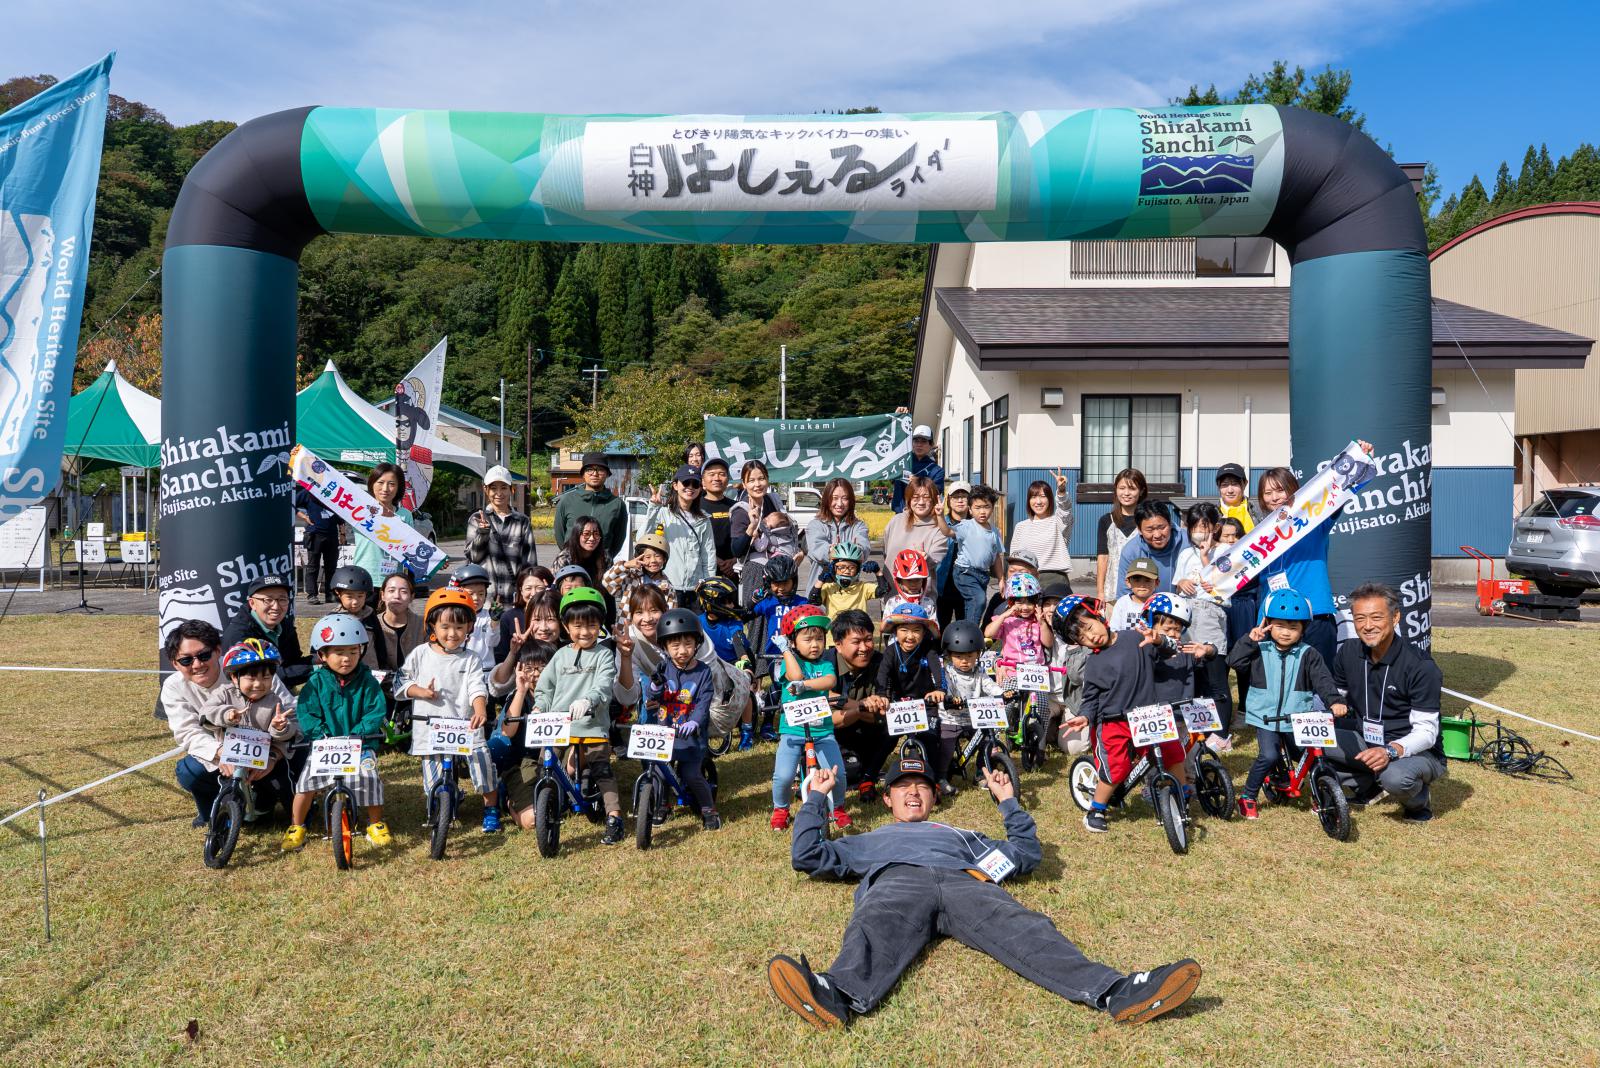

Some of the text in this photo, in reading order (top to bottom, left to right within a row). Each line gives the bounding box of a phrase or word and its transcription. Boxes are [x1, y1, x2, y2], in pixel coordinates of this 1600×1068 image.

[1140, 118, 1252, 134] Shirakami
[672, 127, 910, 140] とびきり陽気なキックバイカーの集い
[1142, 134, 1215, 154] Sanchi
[627, 142, 655, 197] 白神
[890, 138, 949, 198] ライダー
[1138, 195, 1249, 207] Fujisato, Akita, Japan
[34, 236, 76, 440] World Heritage Site
[781, 421, 836, 430] Sirakami
[160, 420, 290, 470] Shirakami
[161, 457, 254, 500] Sanchi
[161, 496, 215, 517] Fujisato,
[220, 487, 267, 504] Akita,
[174, 569, 198, 582] Site
[1022, 674, 1045, 684] 409
[793, 705, 822, 718] 301
[894, 712, 920, 724] 401
[976, 709, 1001, 720] 201
[1190, 711, 1213, 723] 202
[533, 724, 563, 736] 407
[1138, 719, 1168, 734] 405
[1301, 725, 1329, 737] 408
[436, 731, 466, 745] 506
[636, 737, 666, 750] 302
[231, 742, 262, 757] 410
[319, 752, 352, 765] 402
[990, 859, 1011, 879] STAFF
